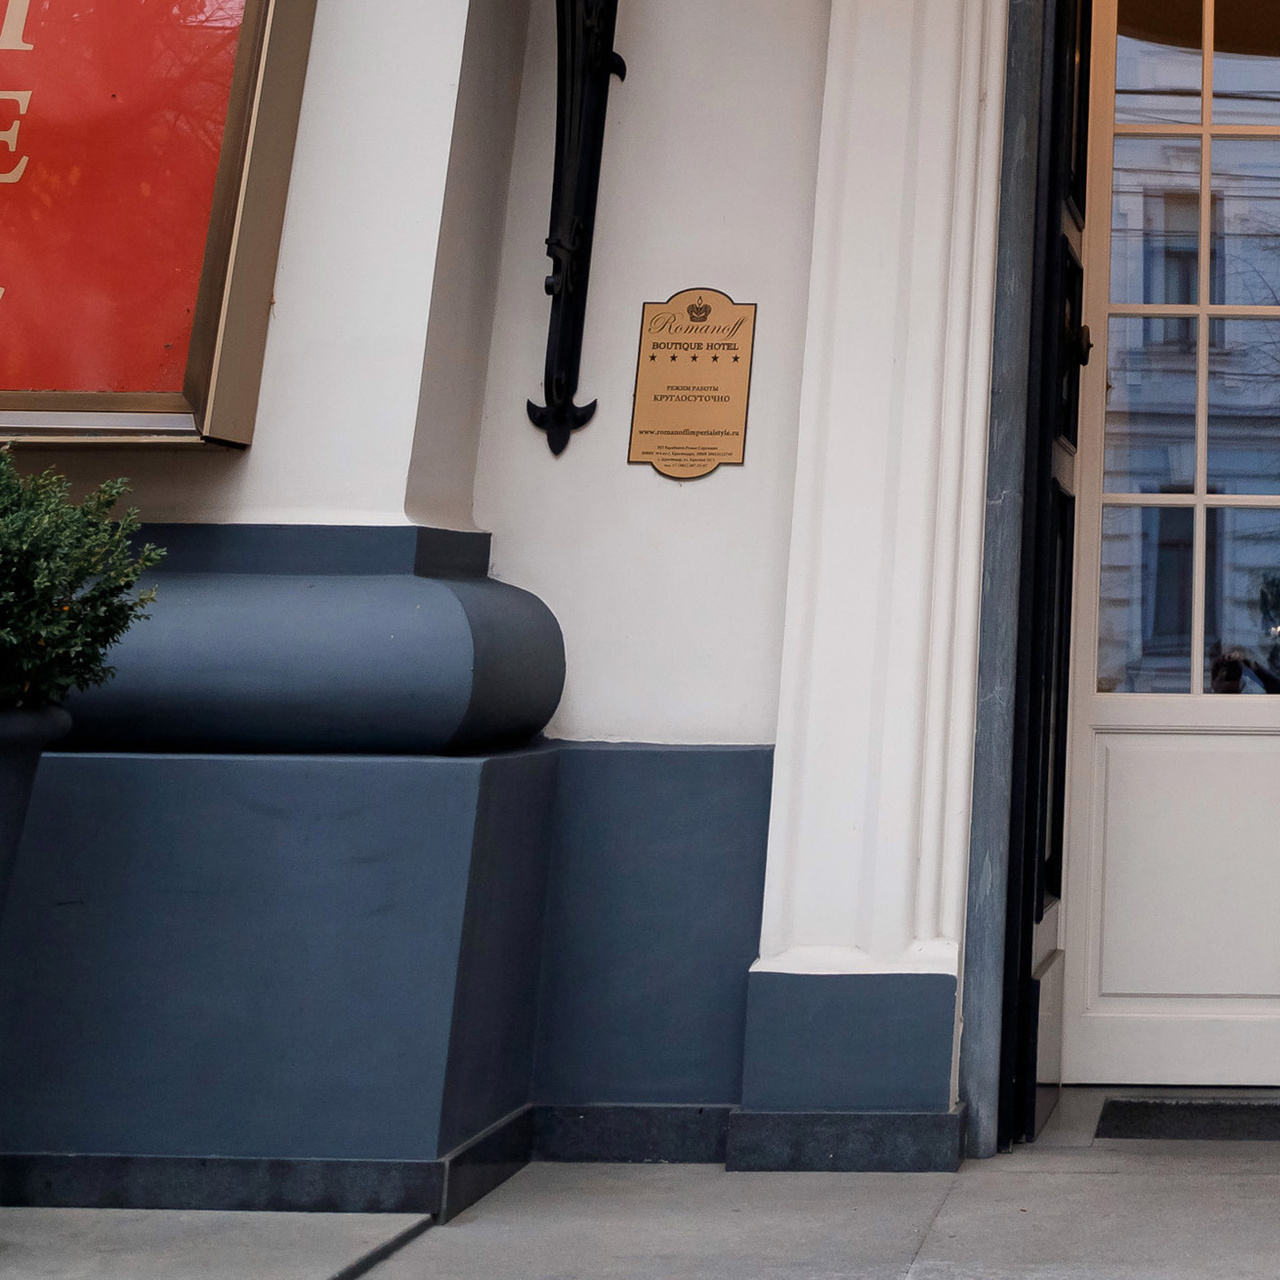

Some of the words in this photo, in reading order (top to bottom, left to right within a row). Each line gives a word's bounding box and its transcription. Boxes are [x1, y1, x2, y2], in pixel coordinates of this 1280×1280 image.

[648, 312, 748, 341] Romanoff
[652, 341, 703, 351] BOUTIQUE
[706, 342, 739, 351] HOTEL
[653, 394, 731, 403] КРУГЛОСУТОЧНО
